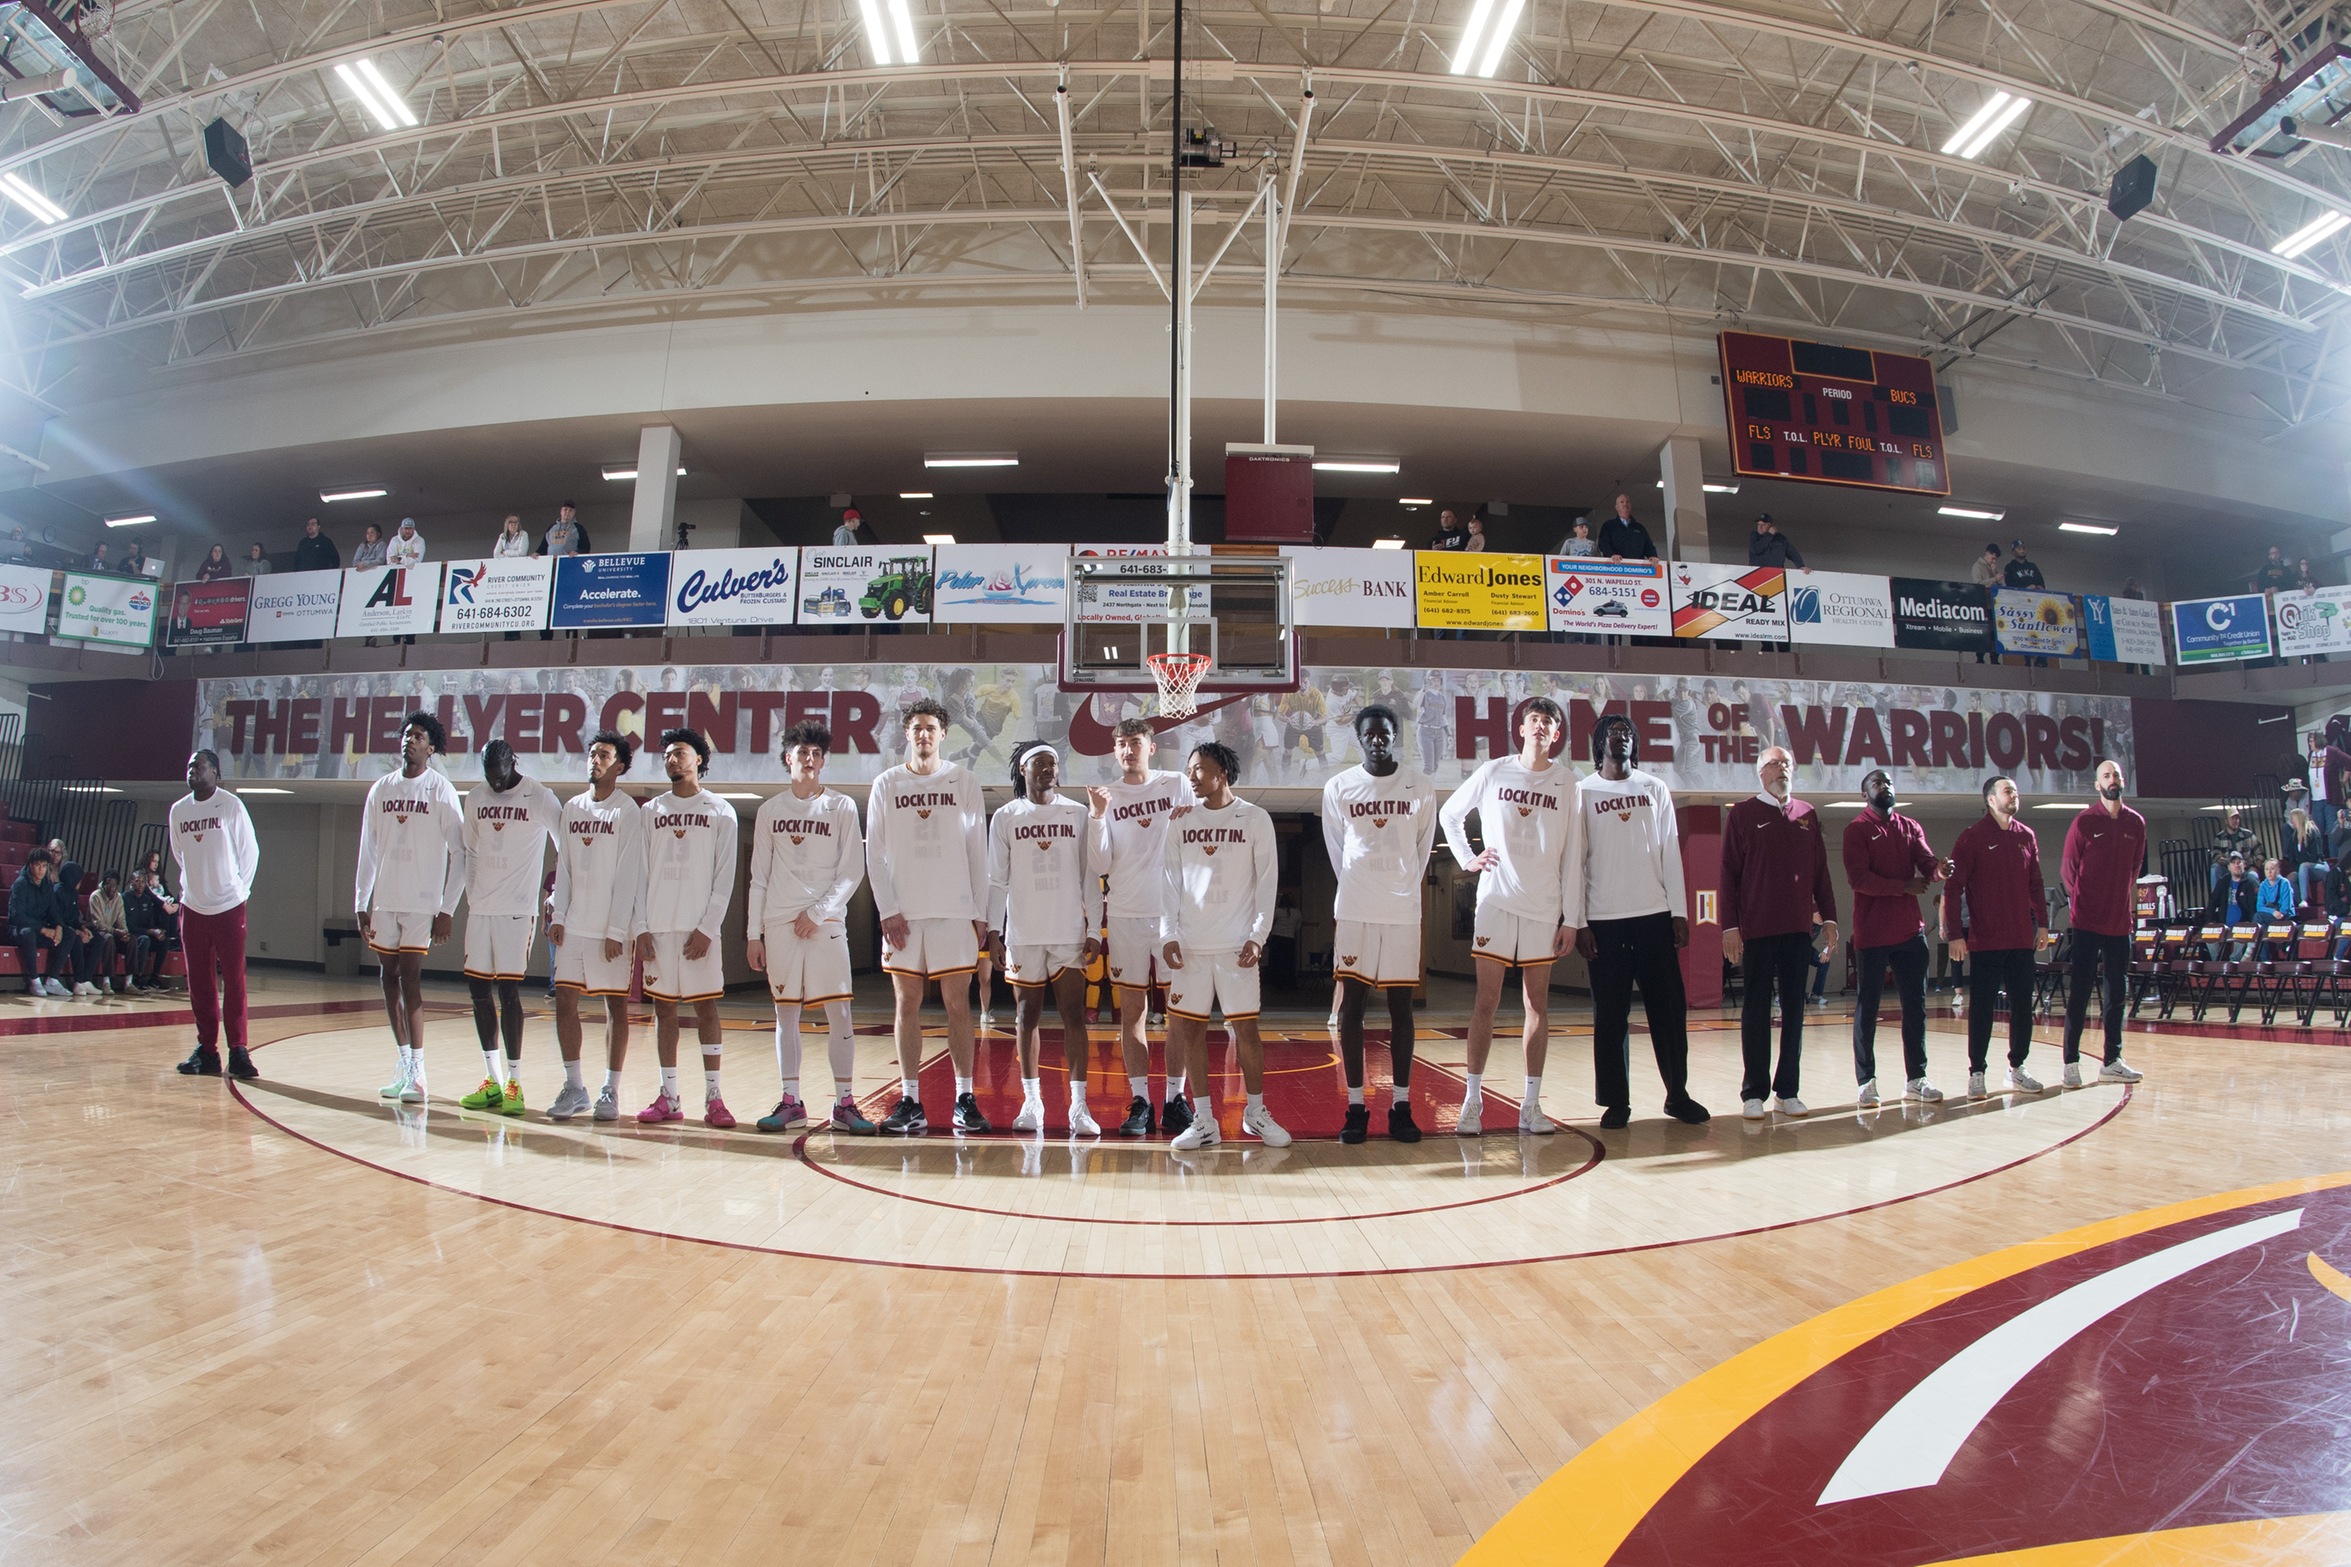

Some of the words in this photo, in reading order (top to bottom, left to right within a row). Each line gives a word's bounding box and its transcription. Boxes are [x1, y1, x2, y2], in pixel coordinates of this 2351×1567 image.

[1736, 370, 1793, 388] WARRIORS
[1890, 390, 1917, 405] BUCS
[1823, 387, 1852, 400] PERIOD
[1748, 424, 1771, 440] FLS
[1783, 431, 1808, 443] T.O.L.
[1813, 432, 1841, 448] PLYR
[1848, 435, 1876, 451] FOUL
[1880, 443, 1902, 454] T.O.L.
[1912, 443, 1933, 459] FLS
[598, 557, 645, 566] BELLEVUE
[813, 556, 872, 568] SINCLAIR
[507, 574, 545, 582] COMMUNITY
[935, 569, 984, 590] Polar
[1418, 566, 1484, 585] Edward
[1487, 568, 1542, 587] Jones
[365, 568, 412, 608] AL
[580, 588, 641, 600] Accelerate.
[677, 558, 789, 614] Culver's
[1363, 581, 1407, 597] BANK
[1589, 587, 1637, 597] 684-5151
[129, 599, 152, 607] AMOCO
[254, 595, 293, 609] GREGG
[296, 592, 336, 606] YOUNG
[1692, 591, 1776, 613] IDEAL
[1830, 593, 1883, 607] OTTUMWA
[65, 612, 89, 620] Trusted
[89, 605, 112, 615] Quality
[296, 608, 333, 616] OTTUMWA
[457, 606, 532, 620] 641-684-6302
[1552, 608, 1586, 616] Domino's
[1823, 604, 1891, 620] REGIONAL
[1900, 597, 1985, 621] Mediacom
[1999, 605, 2036, 620] Sassy
[451, 620, 535, 630] RIVERCOMMUNITYCU.ORG
[1613, 622, 1636, 630] Delivery
[1746, 618, 1769, 626] READY
[1905, 623, 1926, 631] Xtream
[2011, 619, 2074, 634] Sunflower
[2186, 634, 2219, 643] Community
[2227, 632, 2243, 640] Credit
[2243, 630, 2260, 638] Union
[2298, 621, 2331, 641] Shop
[1707, 702, 1750, 731] OF
[225, 697, 320, 755] THE
[1781, 704, 2104, 773] WARRIORS!
[1699, 735, 1760, 763] THE
[895, 794, 926, 809] LOCK
[928, 793, 940, 806] IT
[940, 793, 957, 806] IN.
[1498, 787, 1529, 804] LOCK
[1530, 793, 1543, 806] IT
[1543, 795, 1558, 811] IN.
[1595, 797, 1627, 815] LOCK
[1626, 796, 1638, 809] IT
[1638, 794, 1653, 807] IN.
[382, 800, 405, 813] LOCK
[406, 800, 415, 813] IT
[415, 800, 429, 815] IN.
[477, 806, 501, 820] LOCK
[502, 806, 512, 819] IT
[513, 807, 529, 822] IN.
[1113, 802, 1145, 822] LOCK
[1145, 799, 1157, 814] IT
[1158, 797, 1173, 812] IN.
[1349, 801, 1382, 818] LOCK
[1384, 800, 1395, 814] IT
[1397, 801, 1413, 815] IN.
[180, 818, 200, 834] LOCK
[200, 818, 208, 831] IT
[208, 817, 221, 830] IN.
[592, 820, 601, 833] IT
[600, 820, 614, 835] IN.
[655, 814, 683, 830] LOCK
[683, 813, 694, 826] IT
[694, 814, 710, 828] IN.
[773, 819, 802, 833] LOCK
[802, 819, 815, 833] IT
[815, 821, 831, 837] IN.
[1015, 824, 1046, 840] LOCK
[1047, 824, 1059, 837] IT
[1060, 824, 1076, 838] IN.
[1182, 829, 1213, 844] LOCK
[1215, 829, 1227, 842] IT
[1228, 829, 1246, 843] IN.
